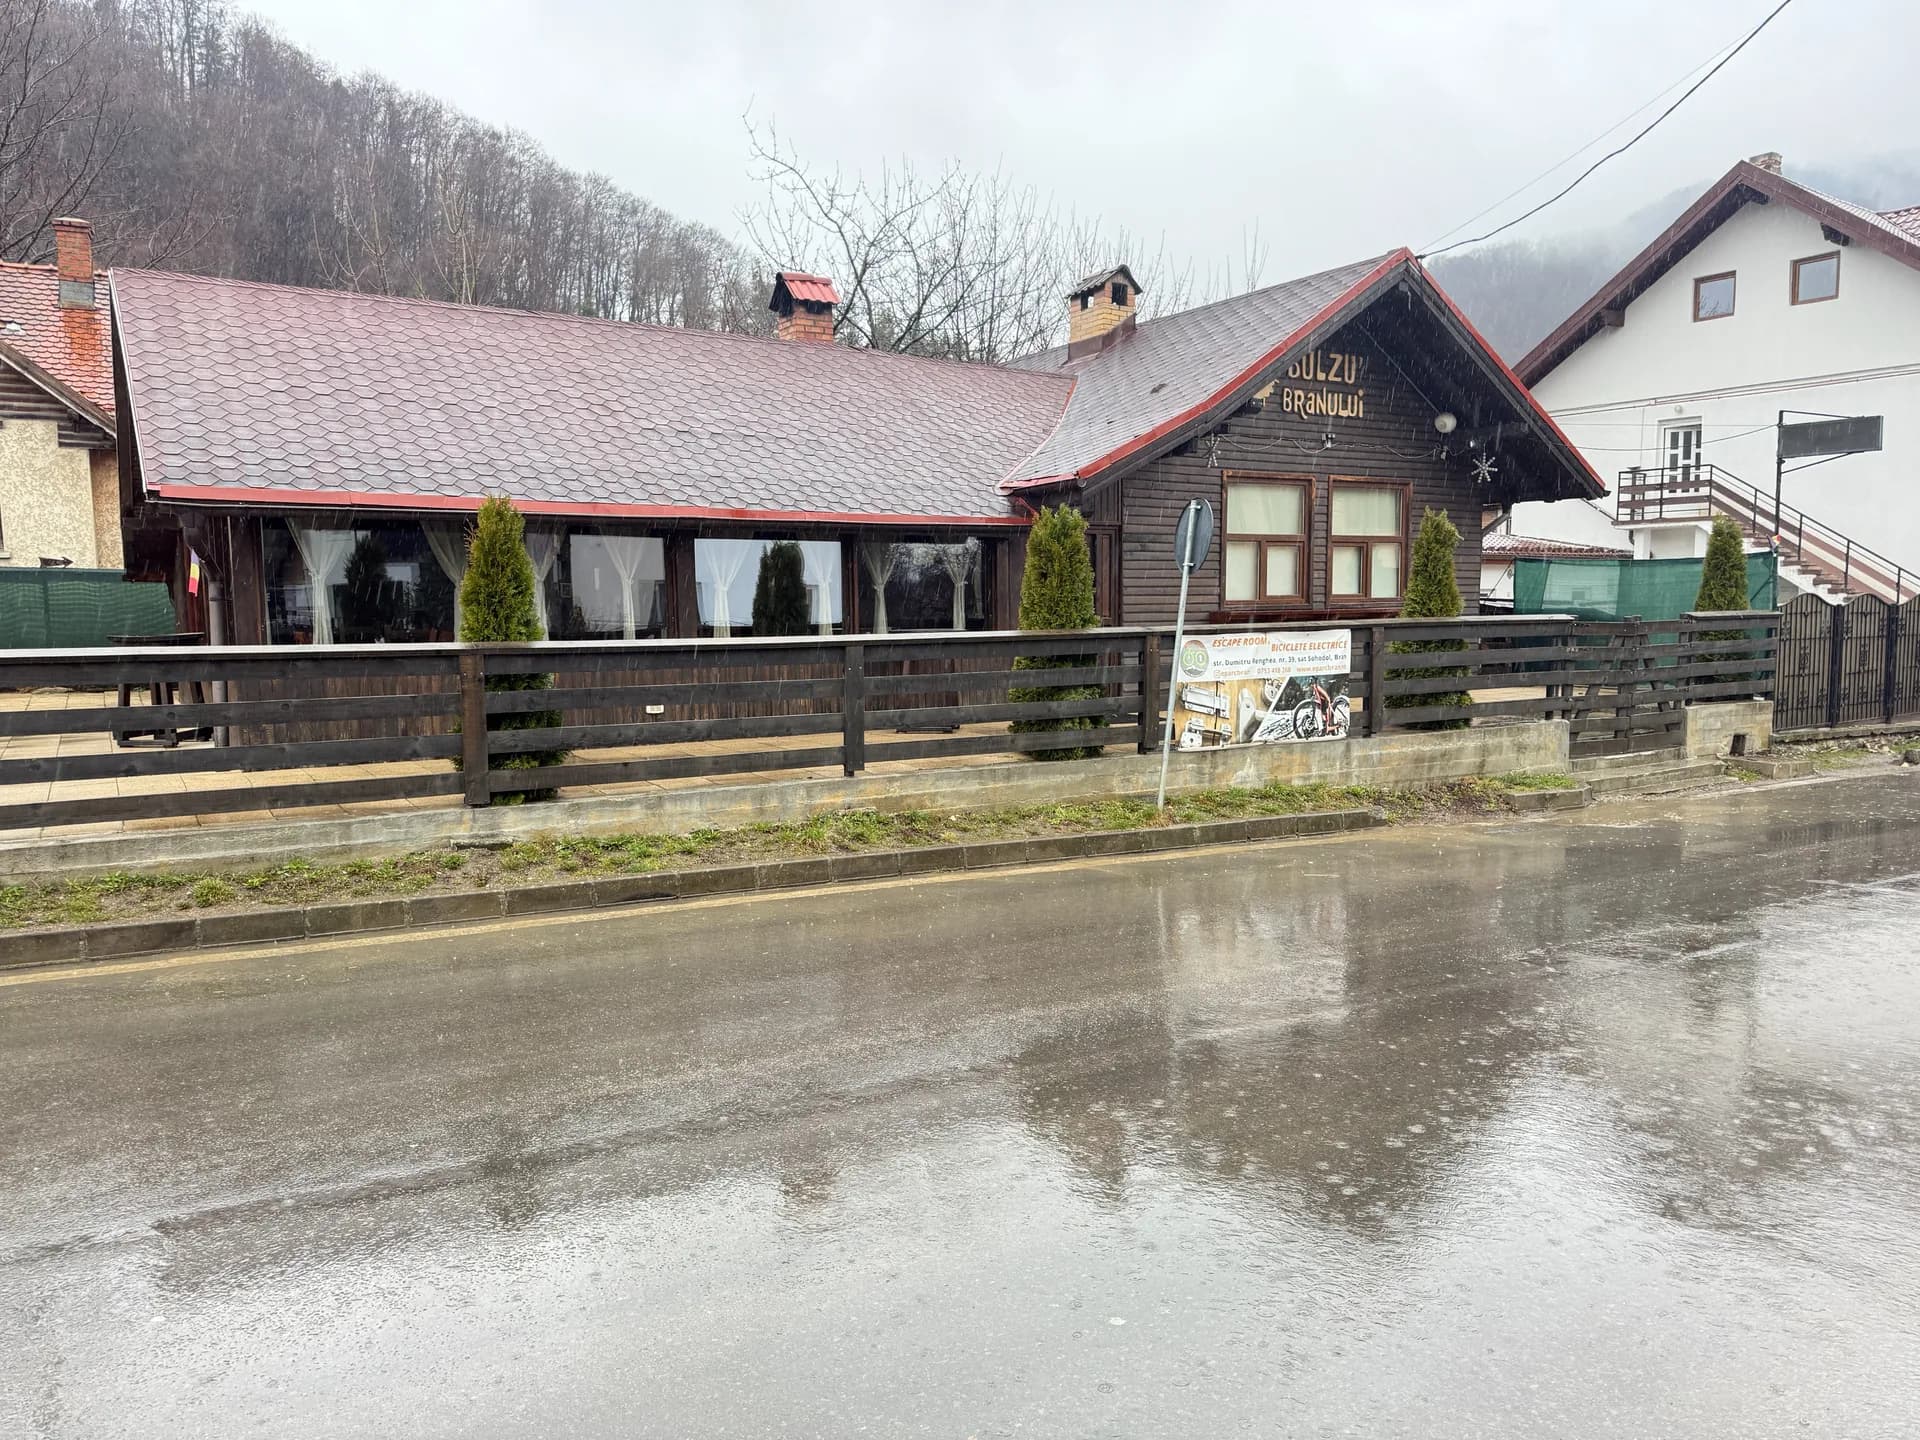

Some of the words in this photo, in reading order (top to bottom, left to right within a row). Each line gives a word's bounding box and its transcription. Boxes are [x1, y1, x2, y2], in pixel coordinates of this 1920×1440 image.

[1212, 637, 1242, 647] ESCAPE
[1271, 642, 1308, 652] BICICLETE
[1308, 640, 1347, 651] ELECTRICE
[1225, 657, 1251, 667] Dumitru
